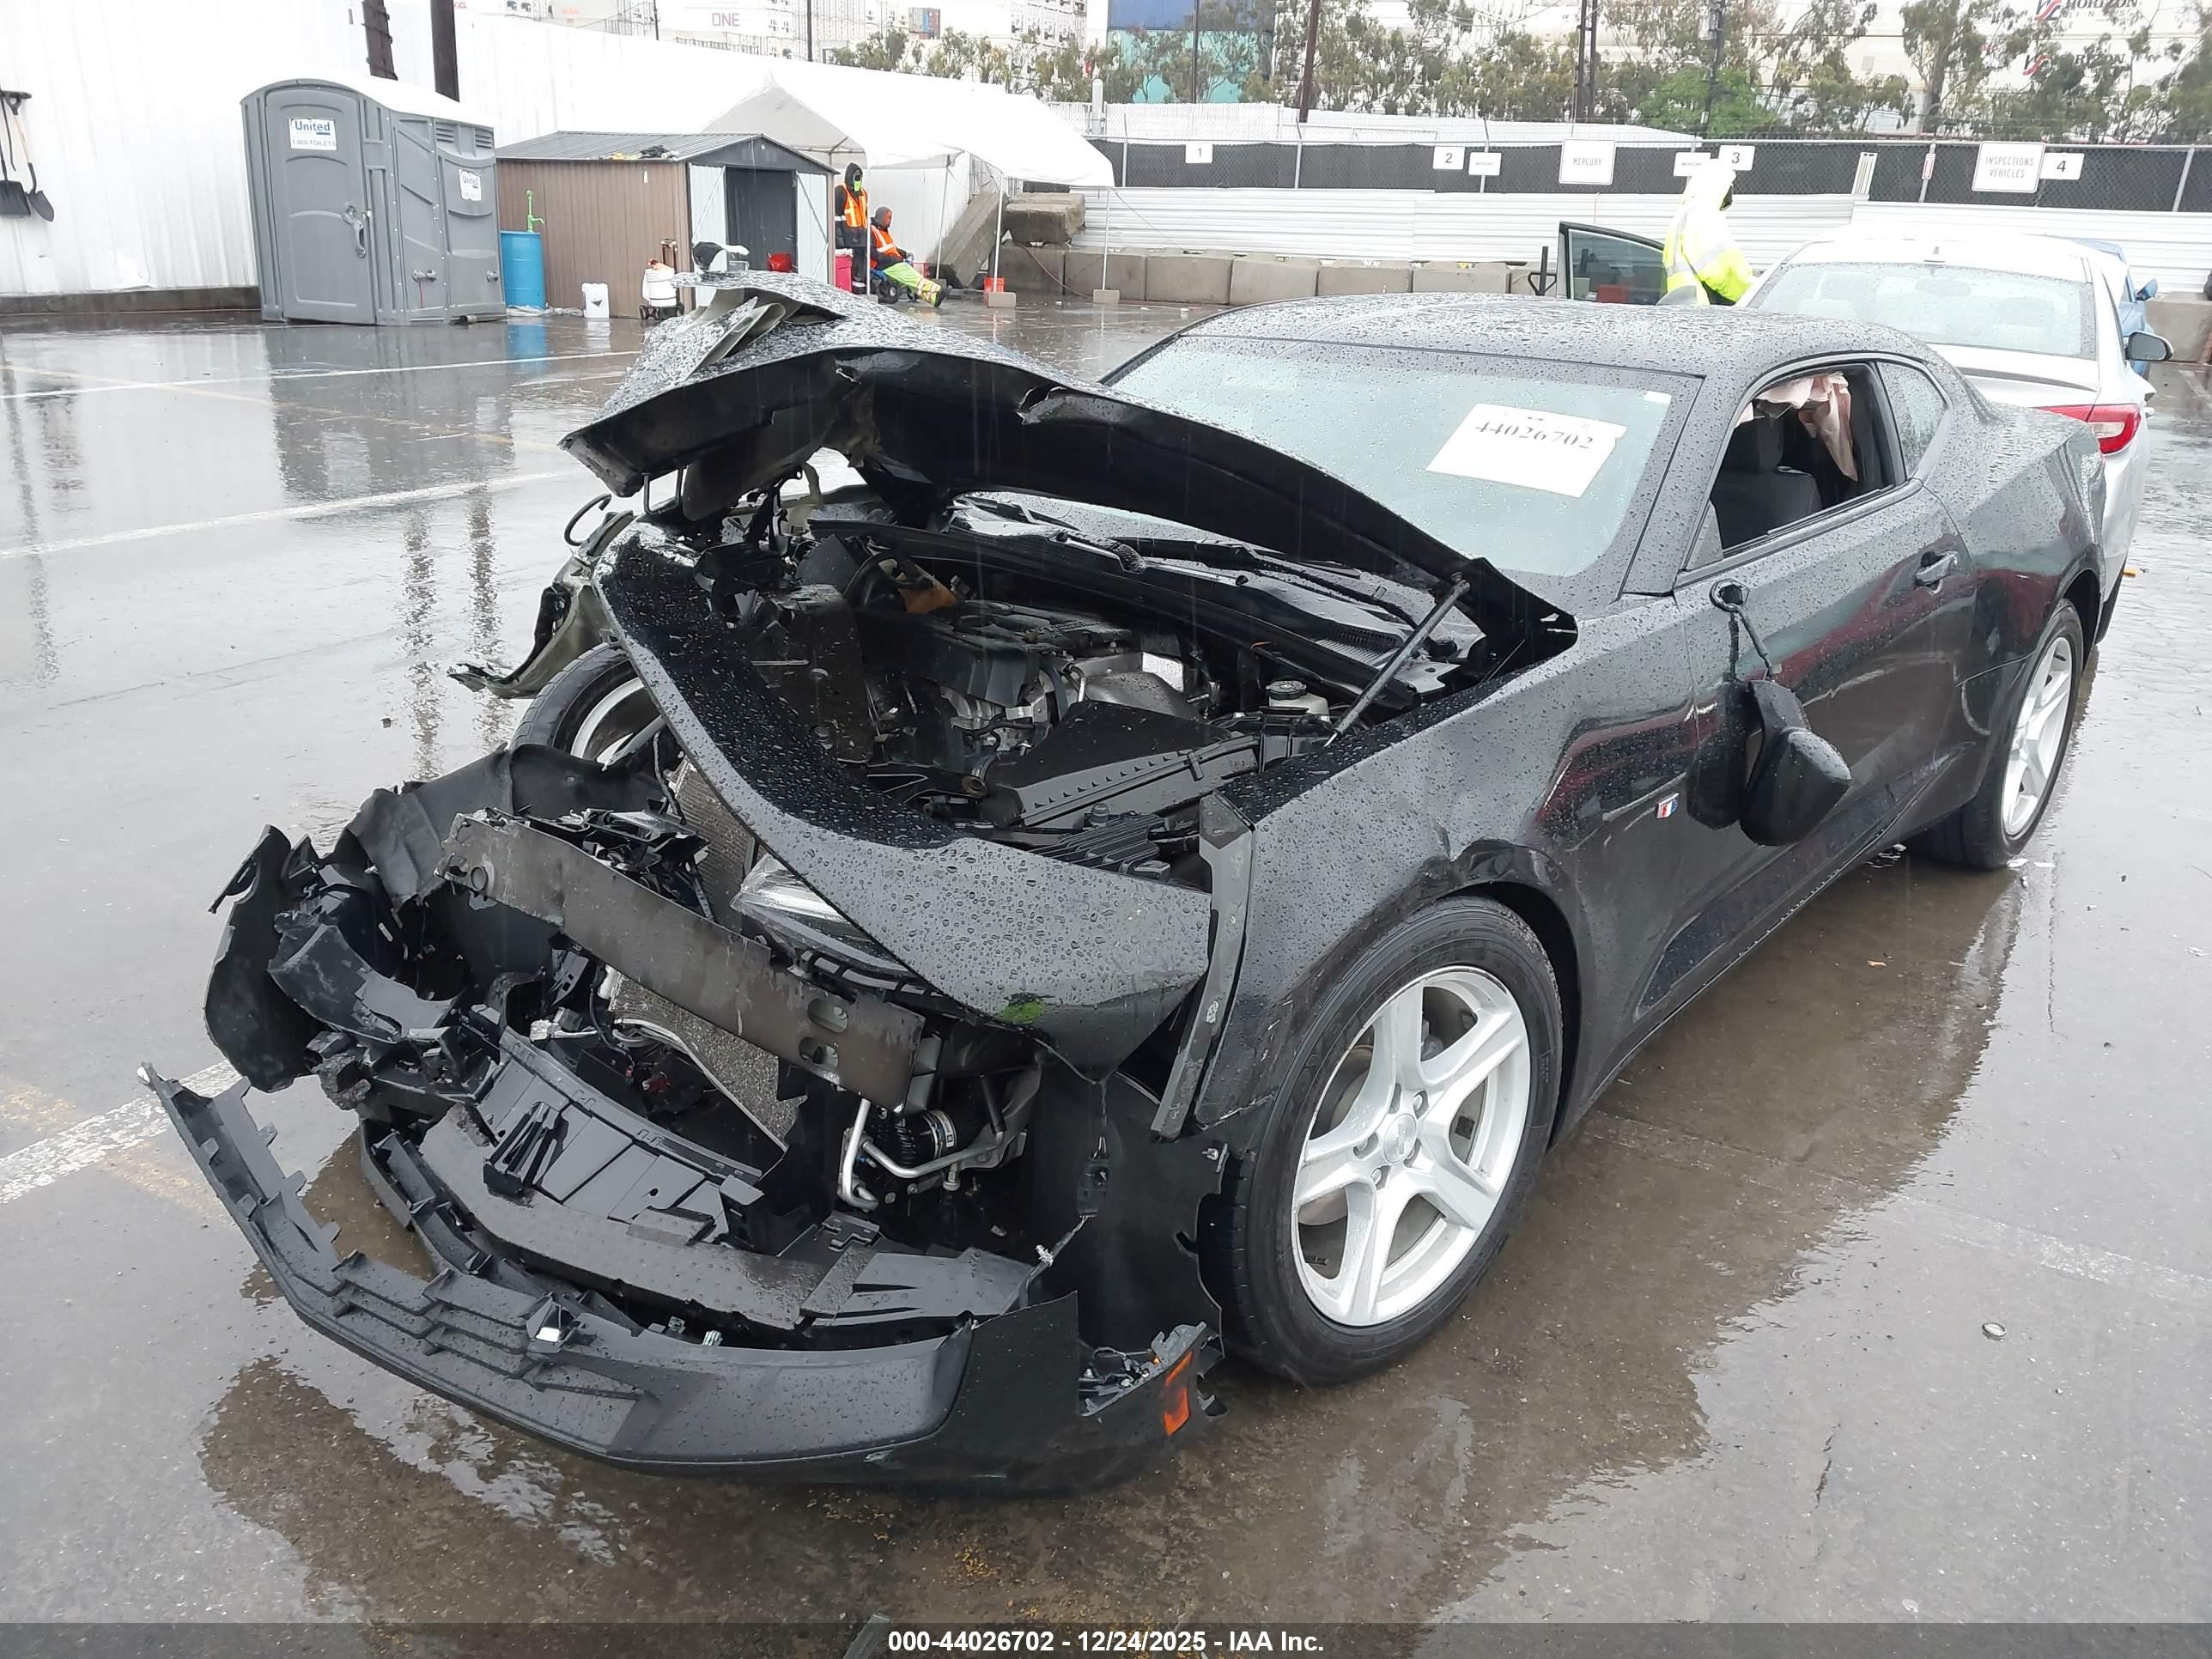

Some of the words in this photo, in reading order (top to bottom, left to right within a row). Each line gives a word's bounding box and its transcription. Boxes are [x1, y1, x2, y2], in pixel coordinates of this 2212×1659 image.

[712, 13, 739, 27] ONE
[295, 120, 331, 131] United
[1196, 146, 1202, 158] 1
[1444, 152, 1453, 164] 2
[1731, 152, 1741, 164] 3
[1572, 157, 1602, 166] MERCURY
[1985, 156, 2033, 166] INSPECTIONS
[2057, 160, 2067, 172] 4
[1990, 168, 2026, 178] VEHICLES
[1475, 421, 1594, 449] 44026702
